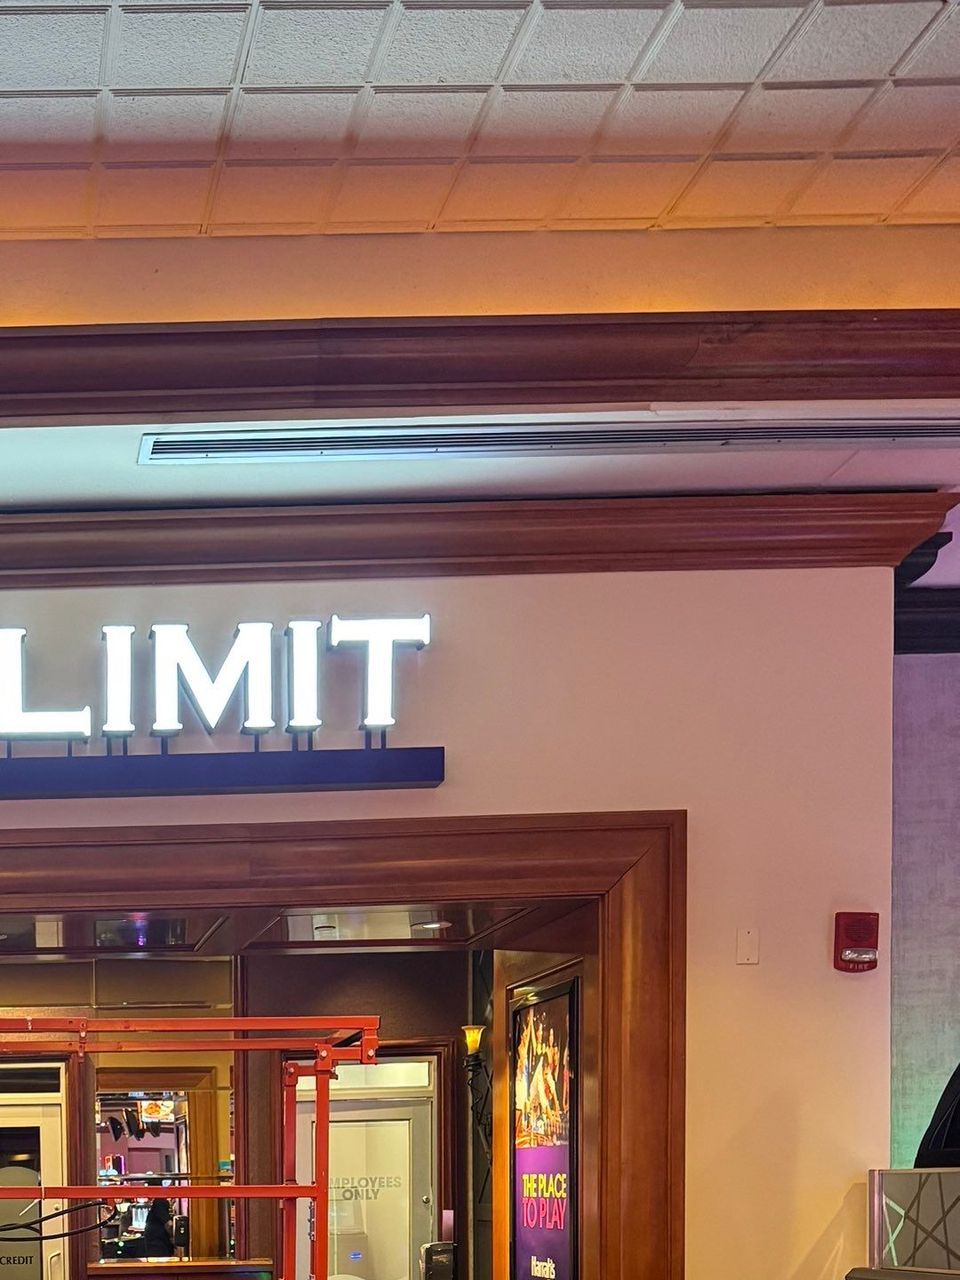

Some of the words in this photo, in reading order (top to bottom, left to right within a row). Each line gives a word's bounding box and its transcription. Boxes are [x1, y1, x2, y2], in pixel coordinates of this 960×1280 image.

[329, 1177, 402, 1188] MPLOYEES
[522, 1173, 537, 1198] THE
[538, 1173, 567, 1198] PLACE
[342, 1188, 380, 1200] ONLY
[522, 1198, 537, 1228] TO
[539, 1199, 567, 1230] PLAY
[0, 1255, 34, 1265] CREDIT
